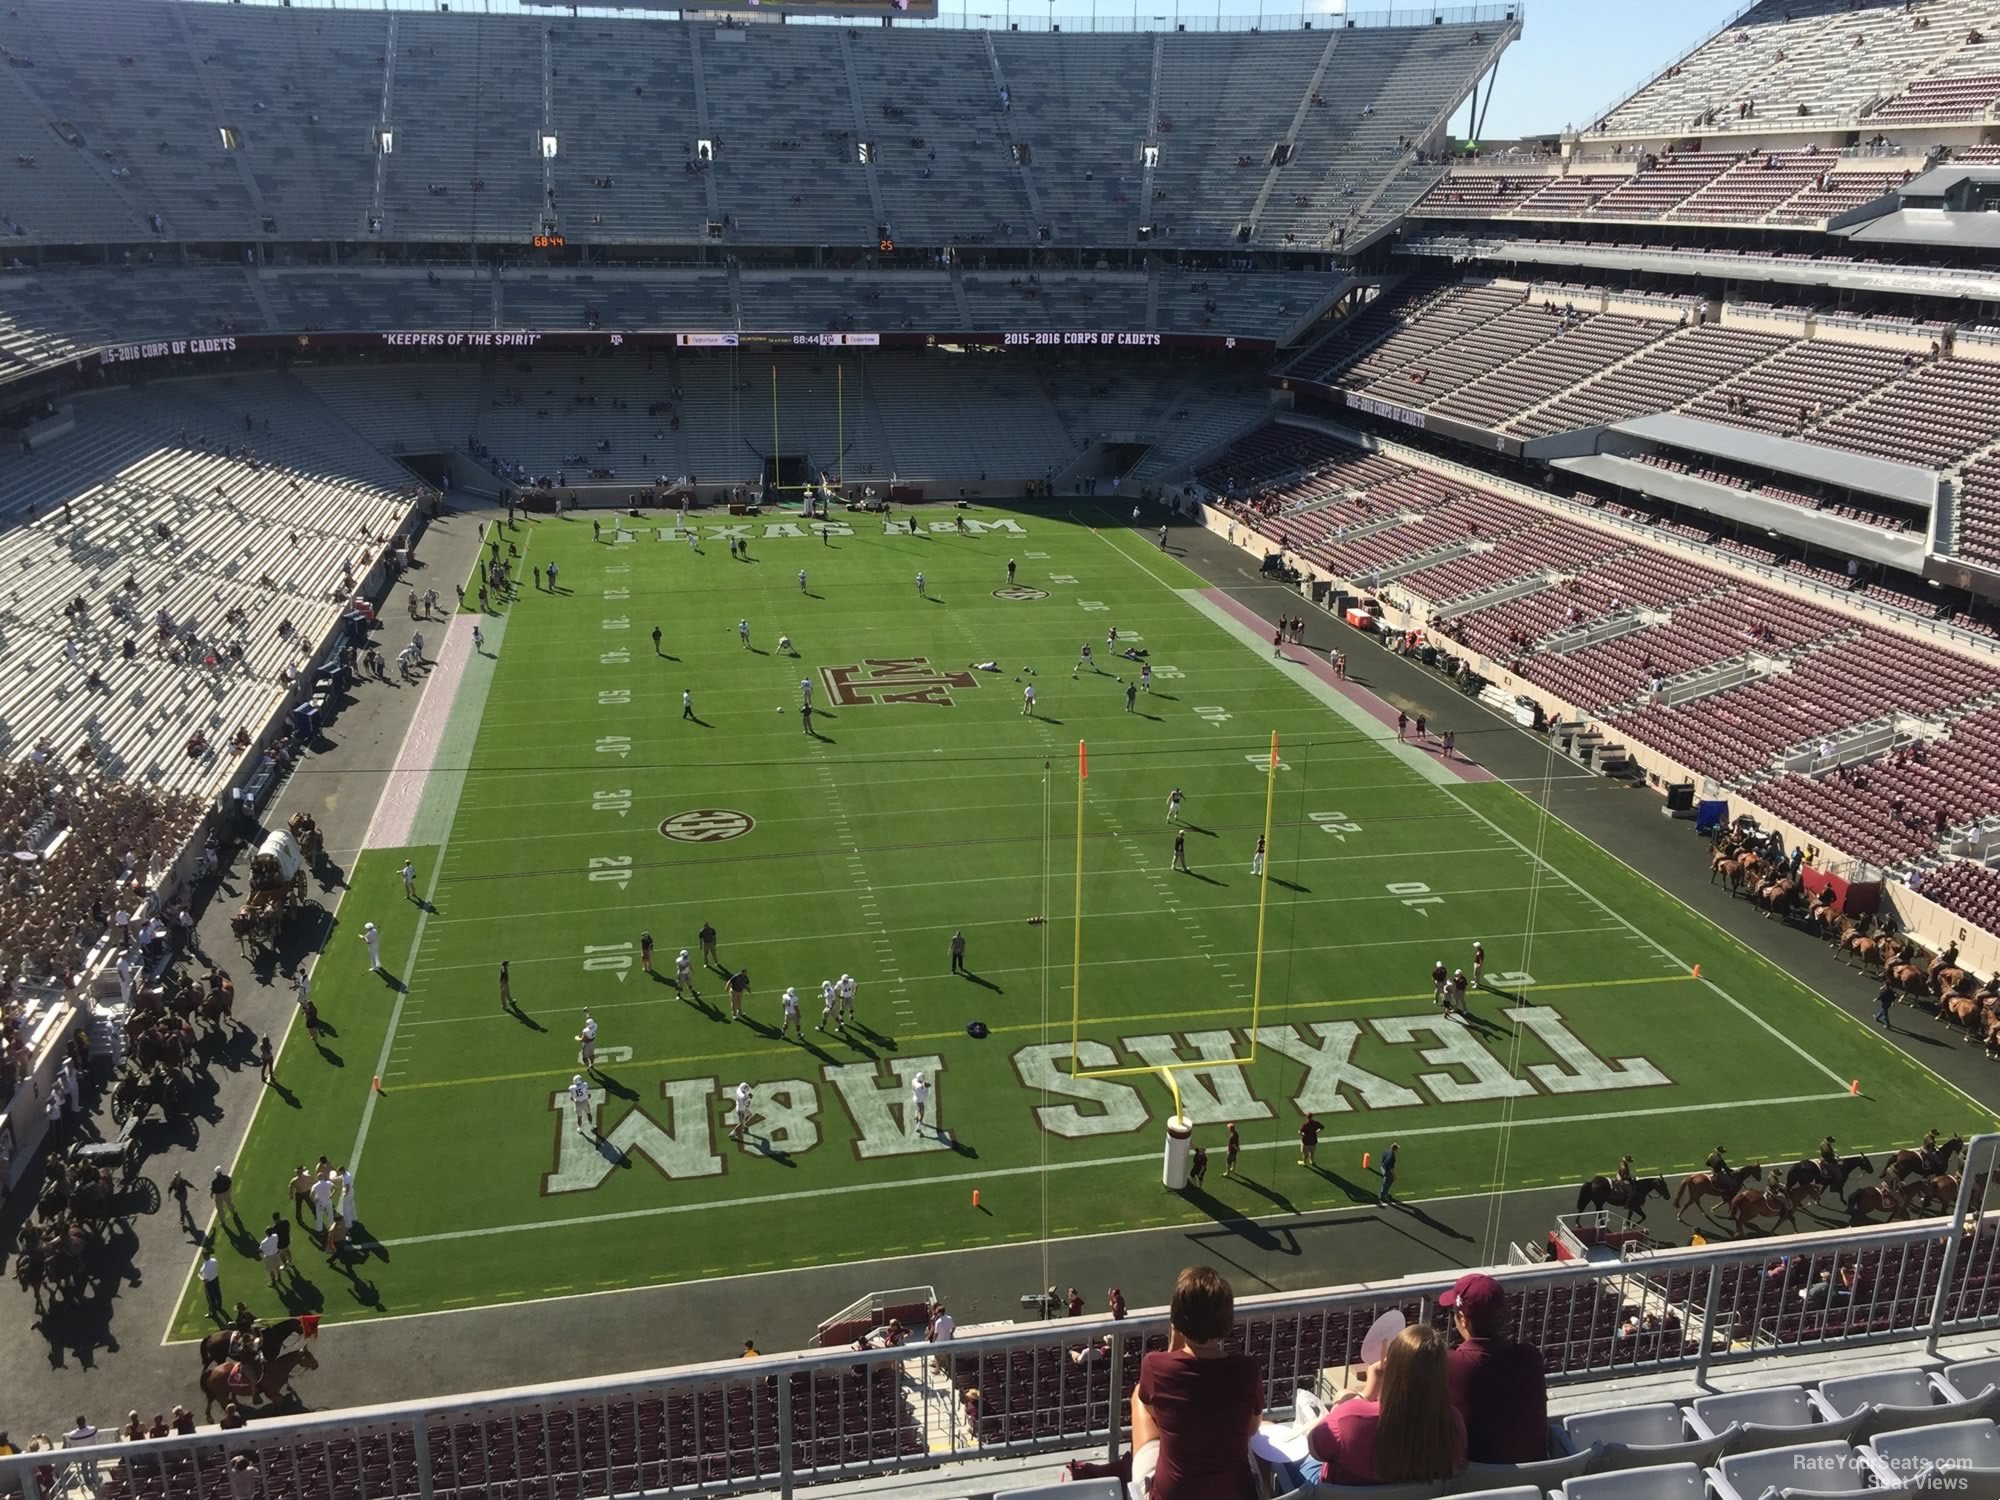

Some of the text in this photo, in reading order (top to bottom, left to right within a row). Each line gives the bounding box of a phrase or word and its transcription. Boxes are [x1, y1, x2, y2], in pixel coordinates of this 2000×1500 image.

[880, 240, 893, 251] 25
[141, 342, 169, 358] CORPS
[171, 341, 188, 354] OF
[190, 337, 237, 353] CADETS
[382, 333, 541, 345] "KEEPERS OF THE SPIRIT"
[793, 335, 820, 344] 68:44
[1004, 333, 1161, 345] 2015-2016 CORPS OF CADETS
[1393, 406, 1400, 421] OF
[598, 689, 631, 704] 50
[1191, 705, 1233, 721] 40
[595, 735, 632, 753] 40
[592, 789, 632, 811] 30
[1307, 811, 1363, 833] 20
[588, 855, 632, 882] 20
[1385, 881, 1446, 906] 10
[583, 941, 633, 971] 10
[540, 1004, 1677, 1196] TEXAS A&M
